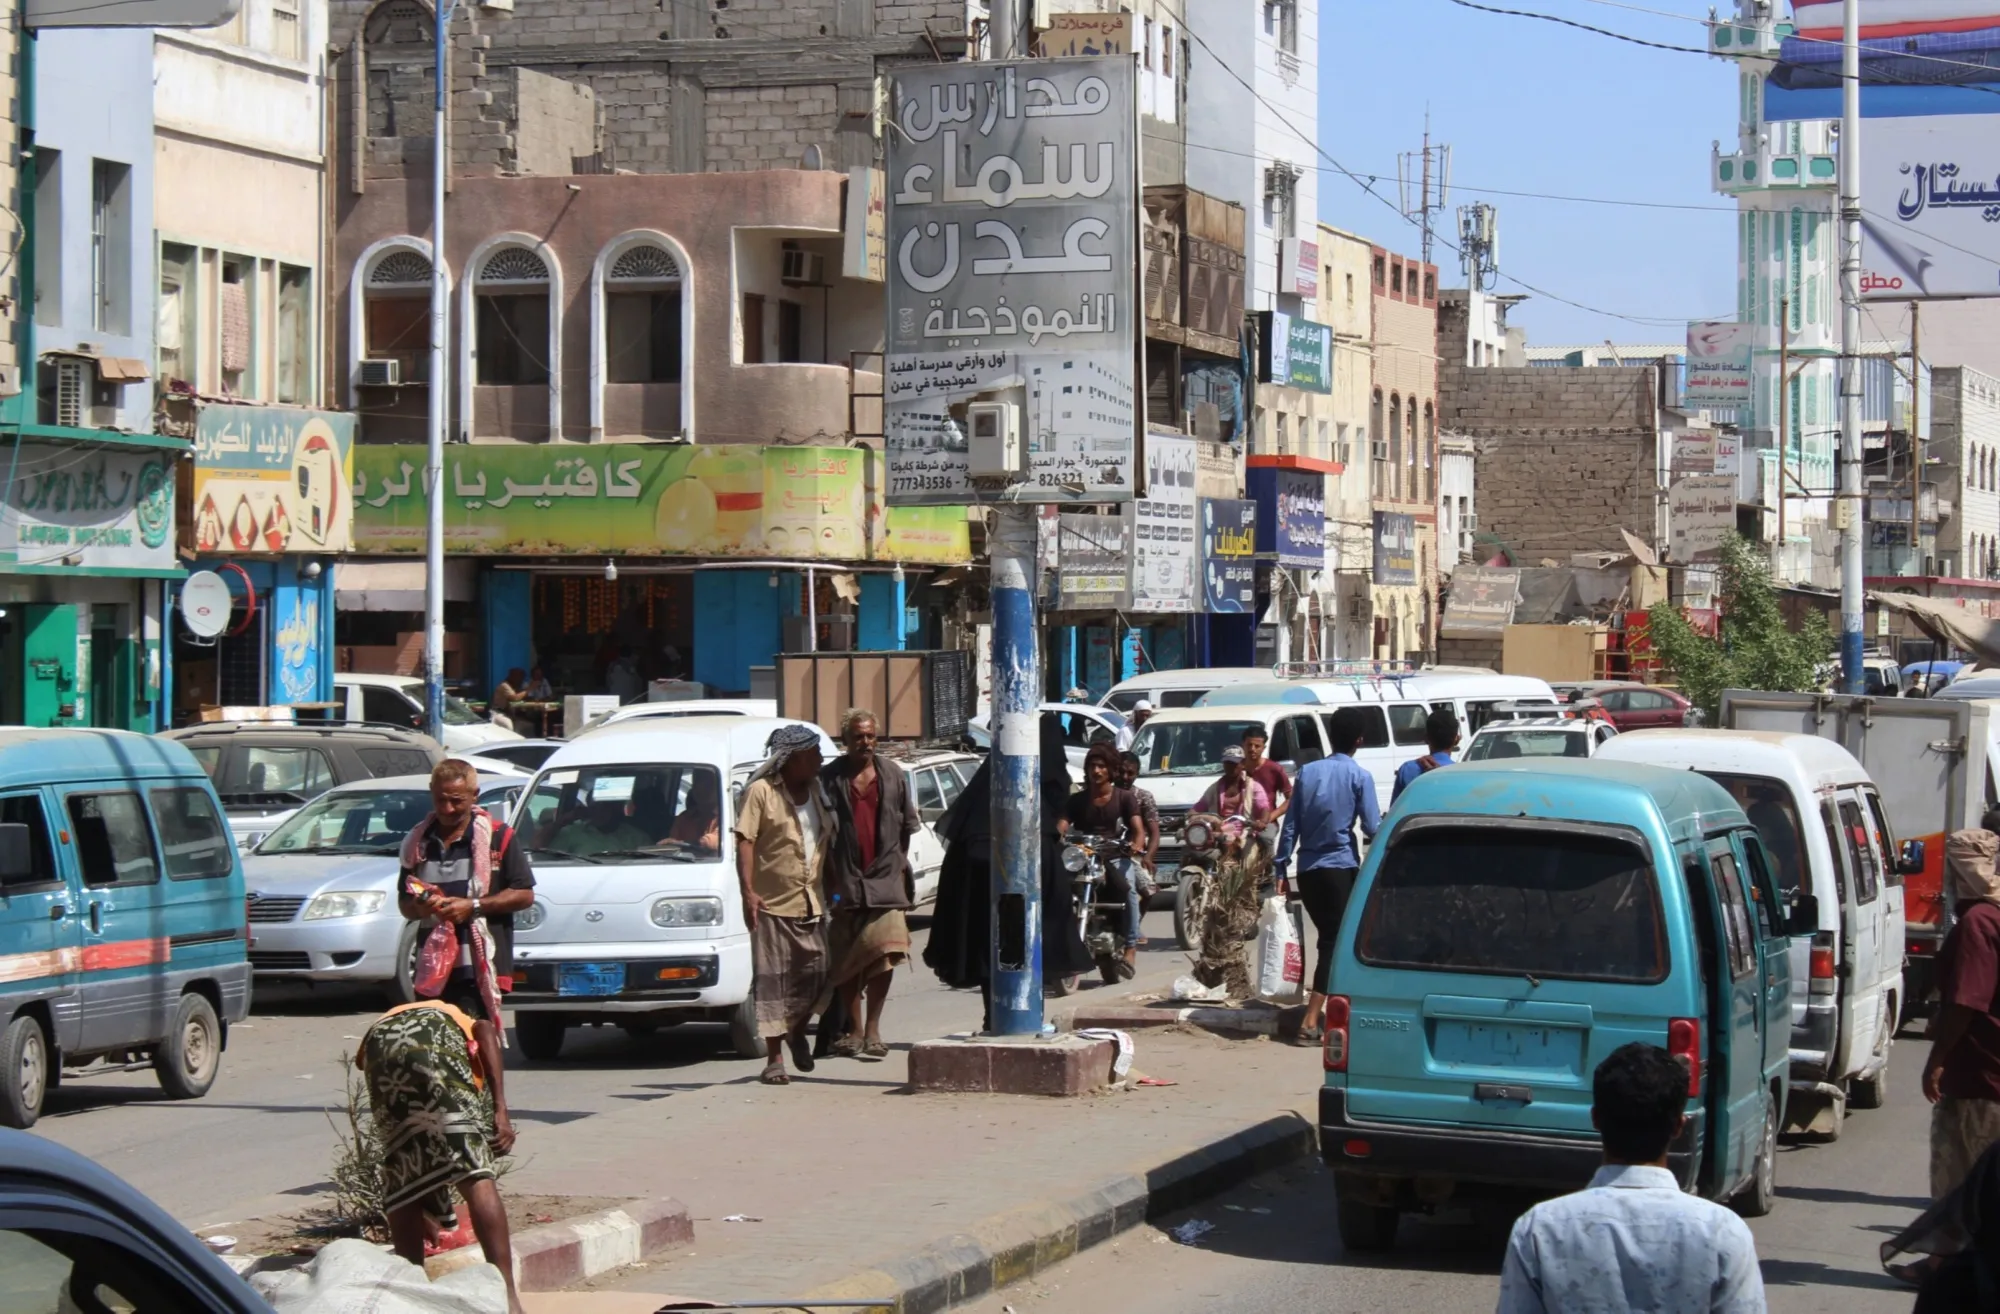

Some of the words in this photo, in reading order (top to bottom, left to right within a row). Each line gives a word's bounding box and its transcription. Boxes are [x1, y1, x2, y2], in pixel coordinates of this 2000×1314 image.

[902, 66, 1111, 142] مدارس
[895, 129, 1114, 208] سماء
[898, 217, 1112, 293] عدن
[923, 293, 1116, 347] النموذجية
[890, 357, 917, 374] أهلية
[920, 360, 953, 373] مدرسة
[956, 353, 985, 371] وأرقى
[988, 350, 1007, 368] أول
[891, 380, 912, 394] عدن
[915, 378, 930, 396] في
[932, 375, 977, 391] نموذجية
[783, 458, 848, 479] كافتيريا
[915, 459, 939, 472] شرطة
[1057, 458, 1076, 470] جوار
[1085, 455, 1126, 469] المنصورة
[454, 457, 643, 509] كافتيريا
[783, 487, 847, 509] الربيع
[1360, 1016, 1400, 1029] DAMAS
